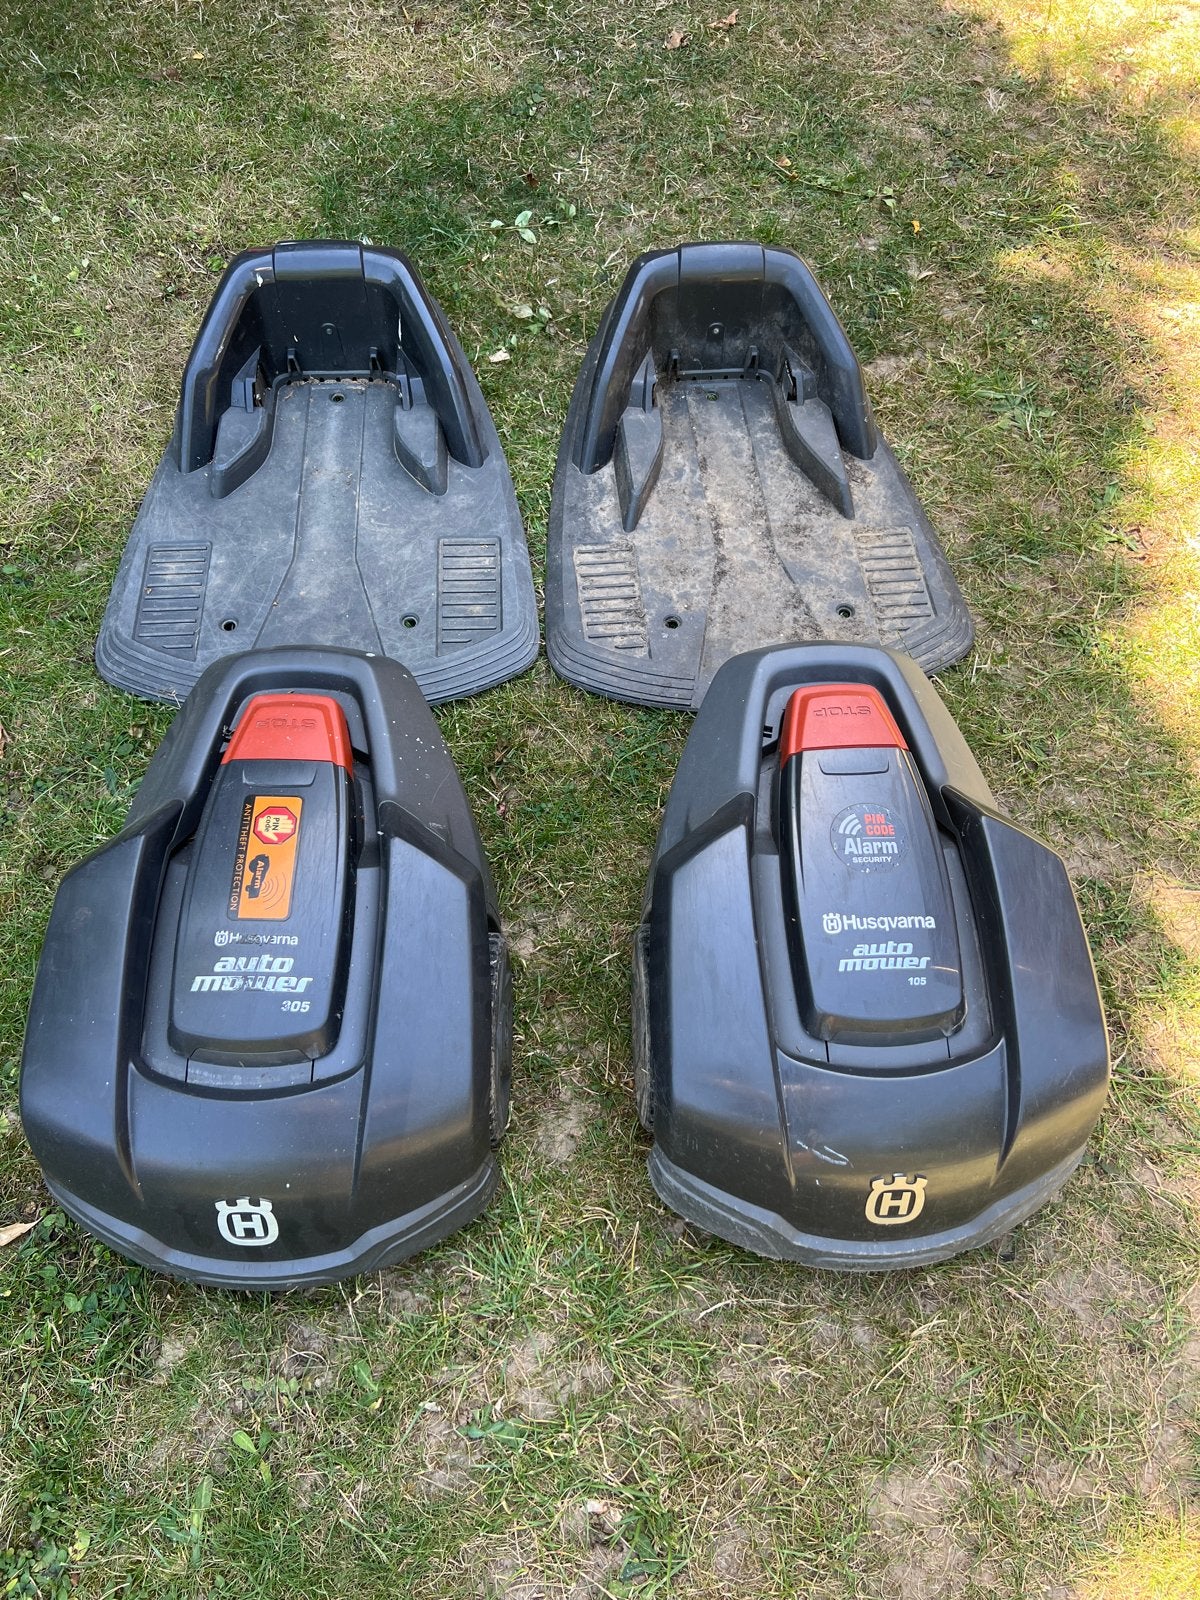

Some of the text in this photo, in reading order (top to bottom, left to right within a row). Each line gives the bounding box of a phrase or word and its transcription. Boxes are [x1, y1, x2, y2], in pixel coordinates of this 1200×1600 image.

[813, 705, 871, 717] STOP
[255, 718, 318, 729] STOP
[271, 817, 280, 831] PIN
[864, 813, 886, 824] PIN
[865, 824, 896, 836] CODE
[844, 837, 899, 855] Alarm
[230, 853, 246, 911] PROTECTION
[253, 860, 265, 889] Alarm
[842, 914, 936, 932] Husqvarna
[852, 940, 914, 956] auto
[213, 954, 294, 973] auto
[838, 956, 931, 972] mower
[190, 975, 314, 993] mower
[907, 976, 927, 986] 105
[281, 1000, 311, 1013] 305
